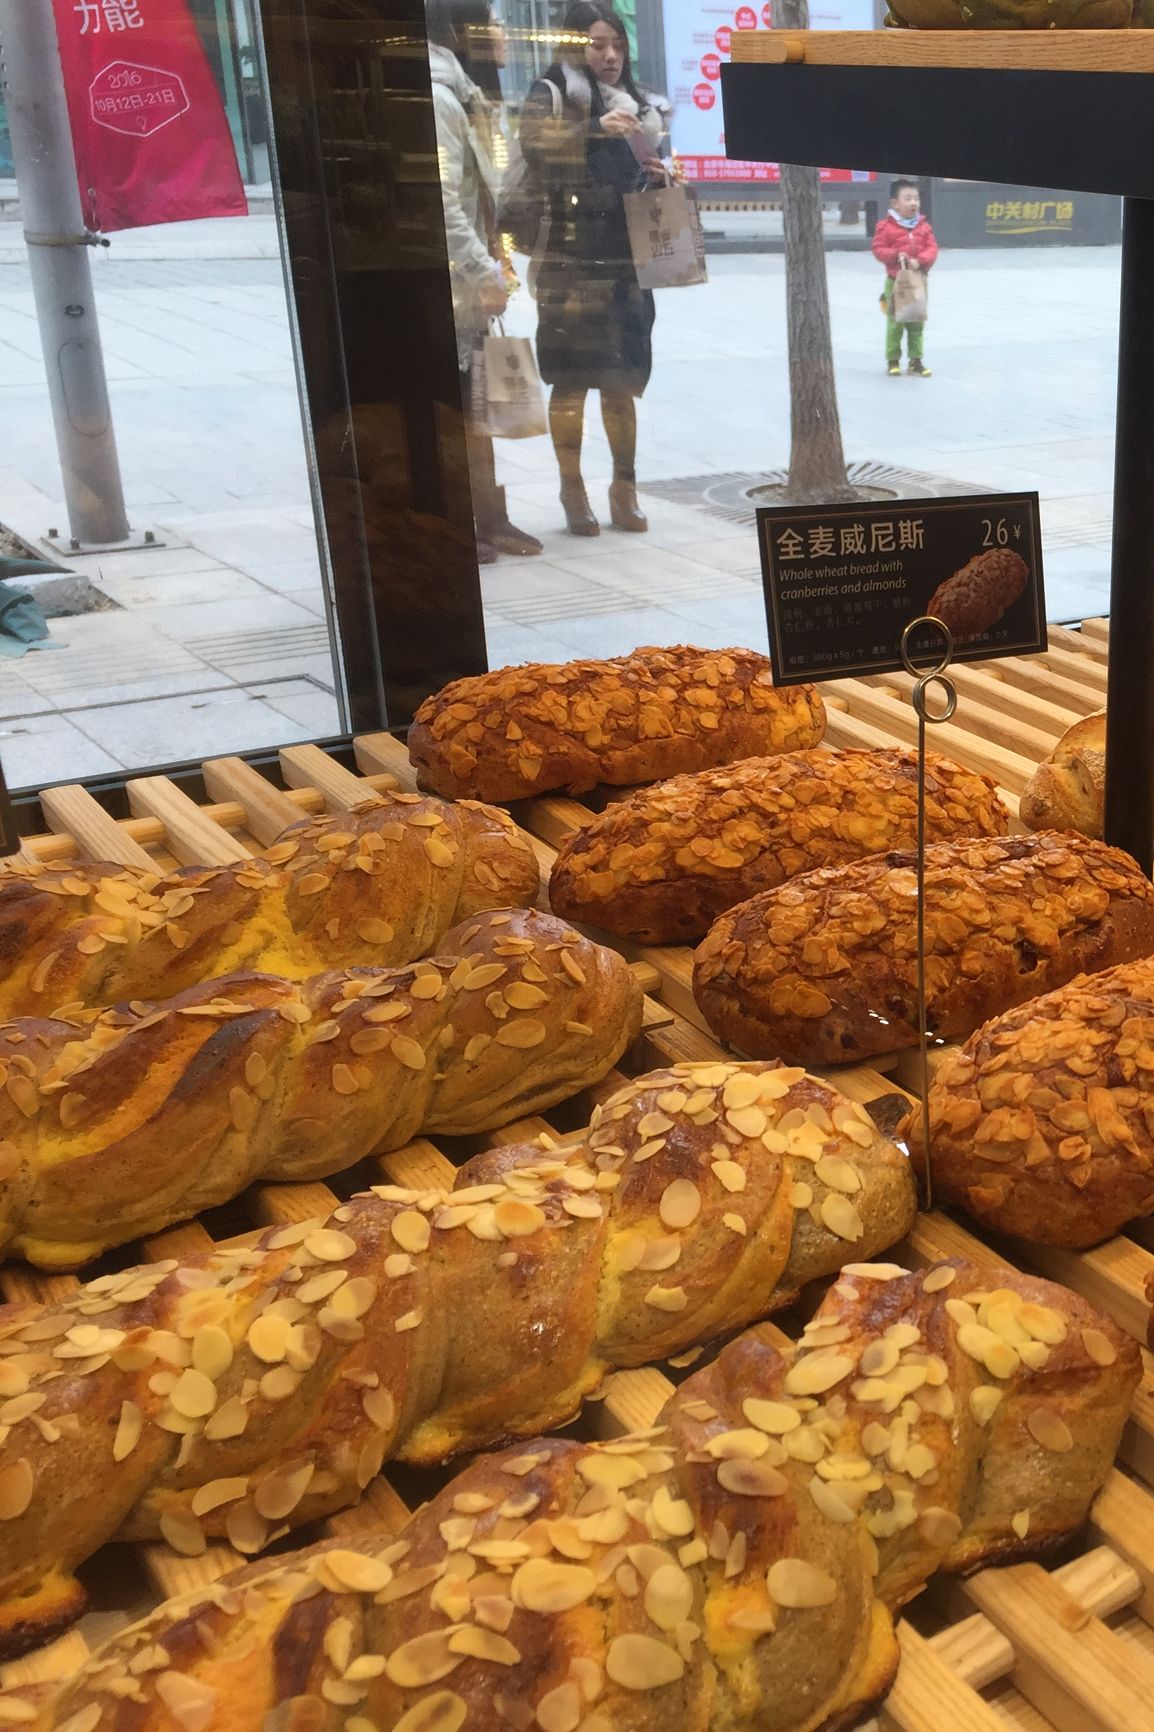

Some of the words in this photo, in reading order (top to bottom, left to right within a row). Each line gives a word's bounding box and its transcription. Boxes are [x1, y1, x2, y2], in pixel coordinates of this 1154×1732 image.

[108, 70, 142, 89] 2016
[95, 89, 176, 112] 10月12日-21日
[776, 519, 925, 560] 全麦威尼斯
[981, 518, 1009, 546] 26
[779, 567, 814, 582] Whole
[815, 564, 848, 579] wheat
[849, 562, 880, 576] bread
[881, 559, 904, 573] with
[780, 583, 840, 601] cranberries
[841, 580, 861, 595] and
[863, 577, 907, 593] almonds
